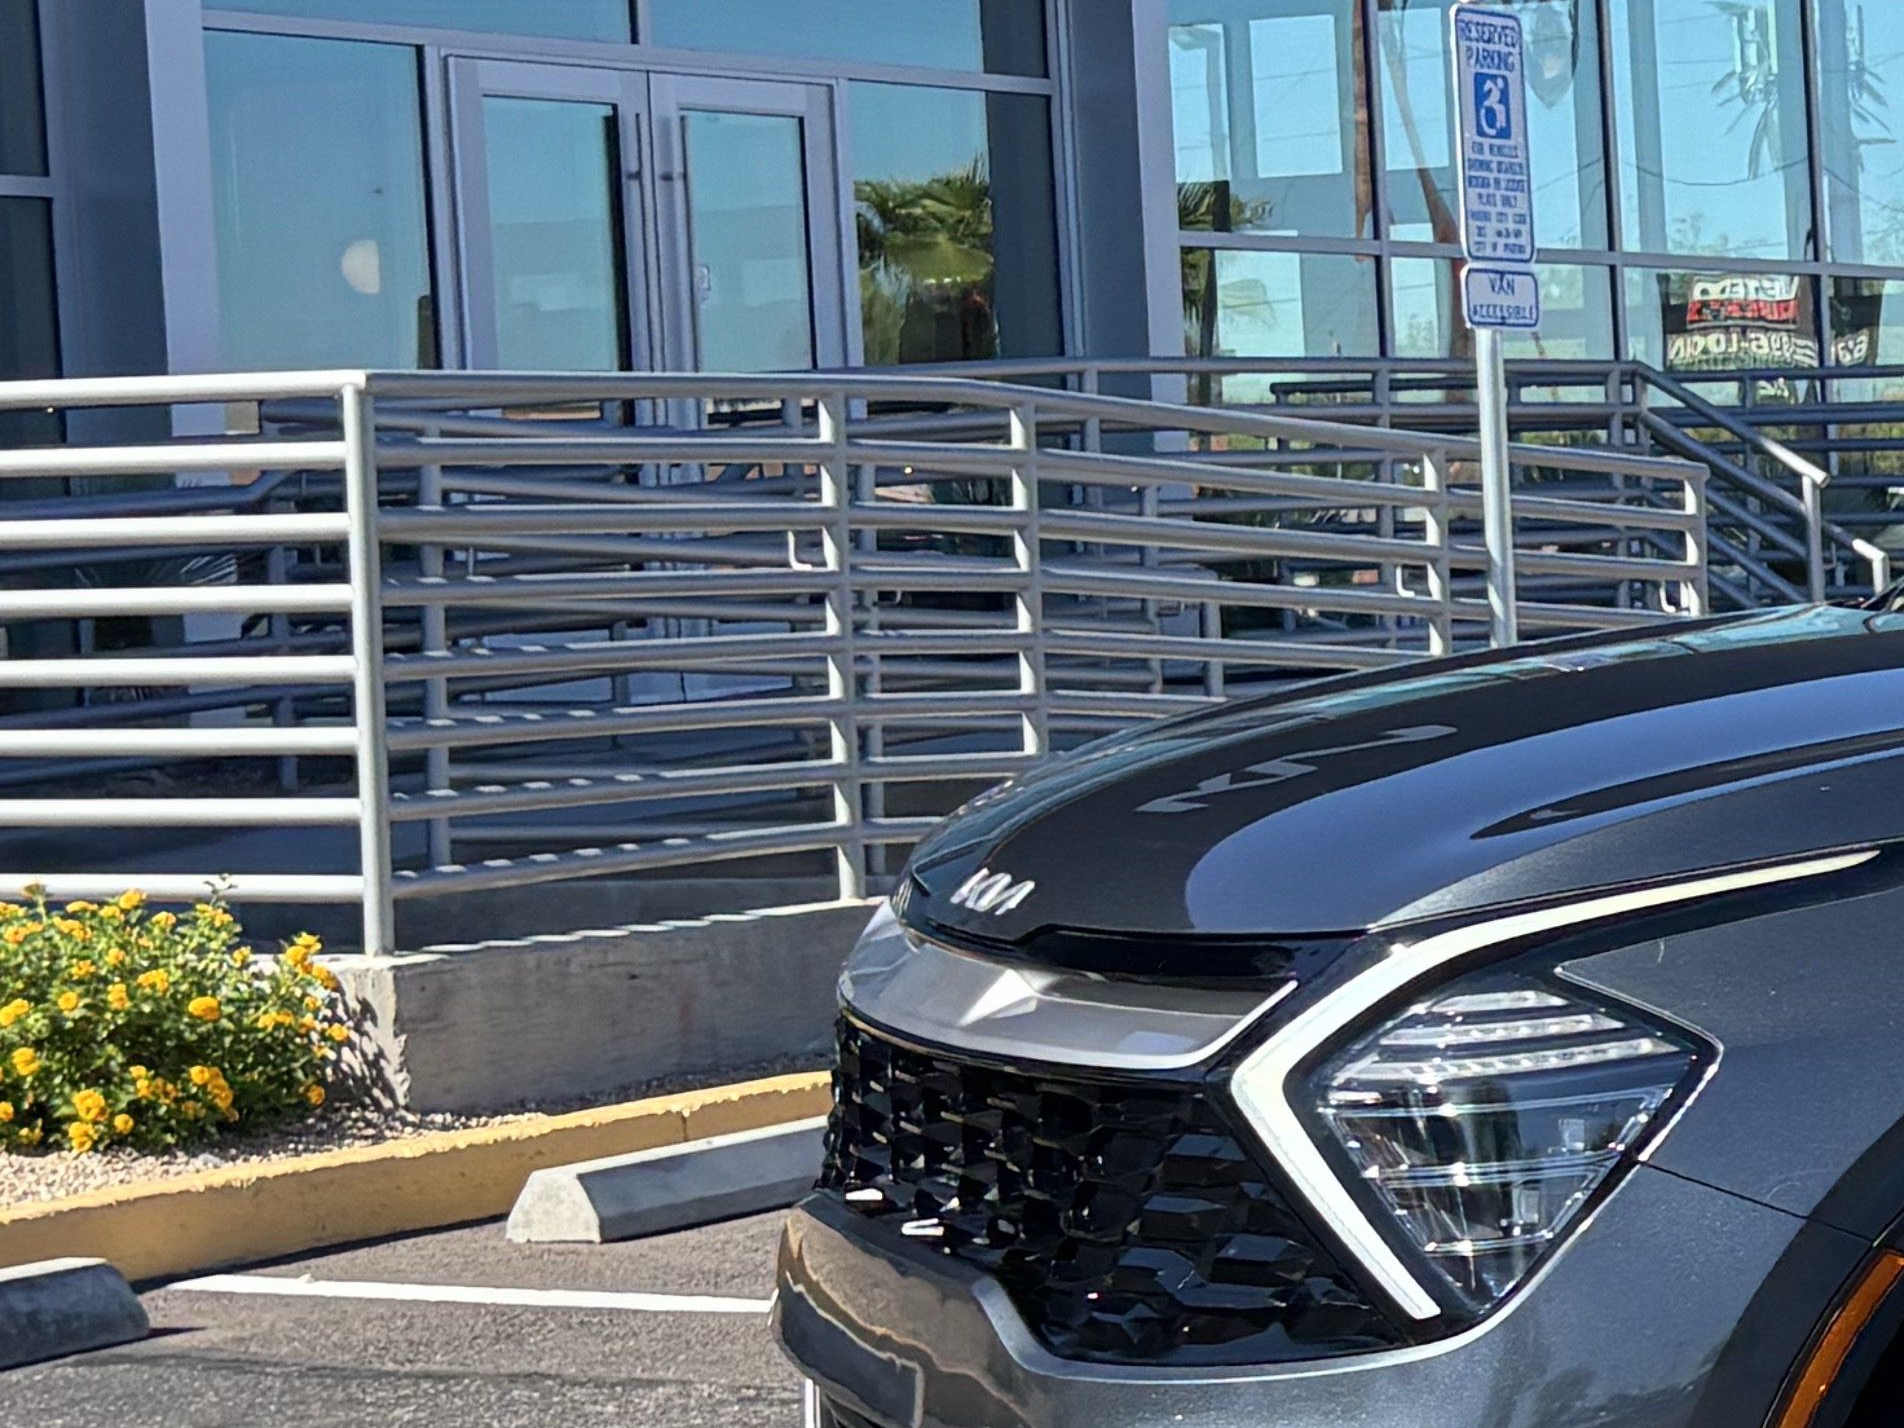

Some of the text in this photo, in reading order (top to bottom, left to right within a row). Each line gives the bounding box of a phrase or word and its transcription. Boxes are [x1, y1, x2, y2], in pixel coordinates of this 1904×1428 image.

[1459, 18, 1518, 49] RESERVED
[1465, 44, 1516, 72] PARKING
[1488, 276, 1515, 296] VAN
[1472, 304, 1534, 320] ACCESSIBLE
[950, 867, 1035, 916] KIA
